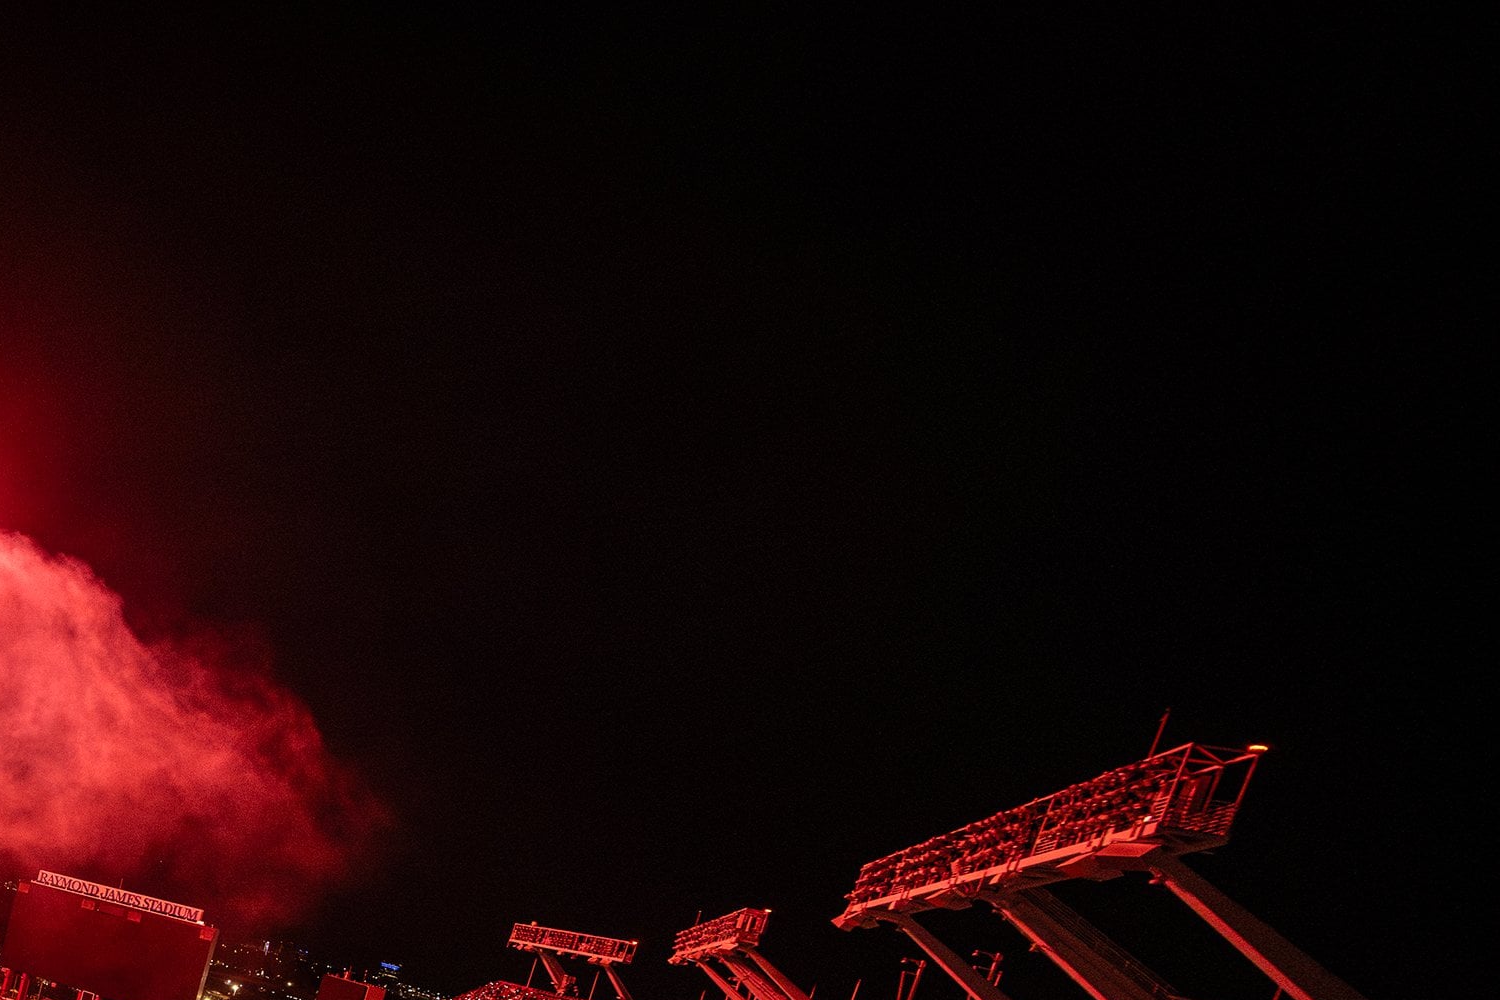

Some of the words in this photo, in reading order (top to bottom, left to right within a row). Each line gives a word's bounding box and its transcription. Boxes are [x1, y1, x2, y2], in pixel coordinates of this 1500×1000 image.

[37, 871, 100, 899] RAYMOND
[100, 888, 143, 906] JAMES
[143, 898, 200, 922] STADIUM
